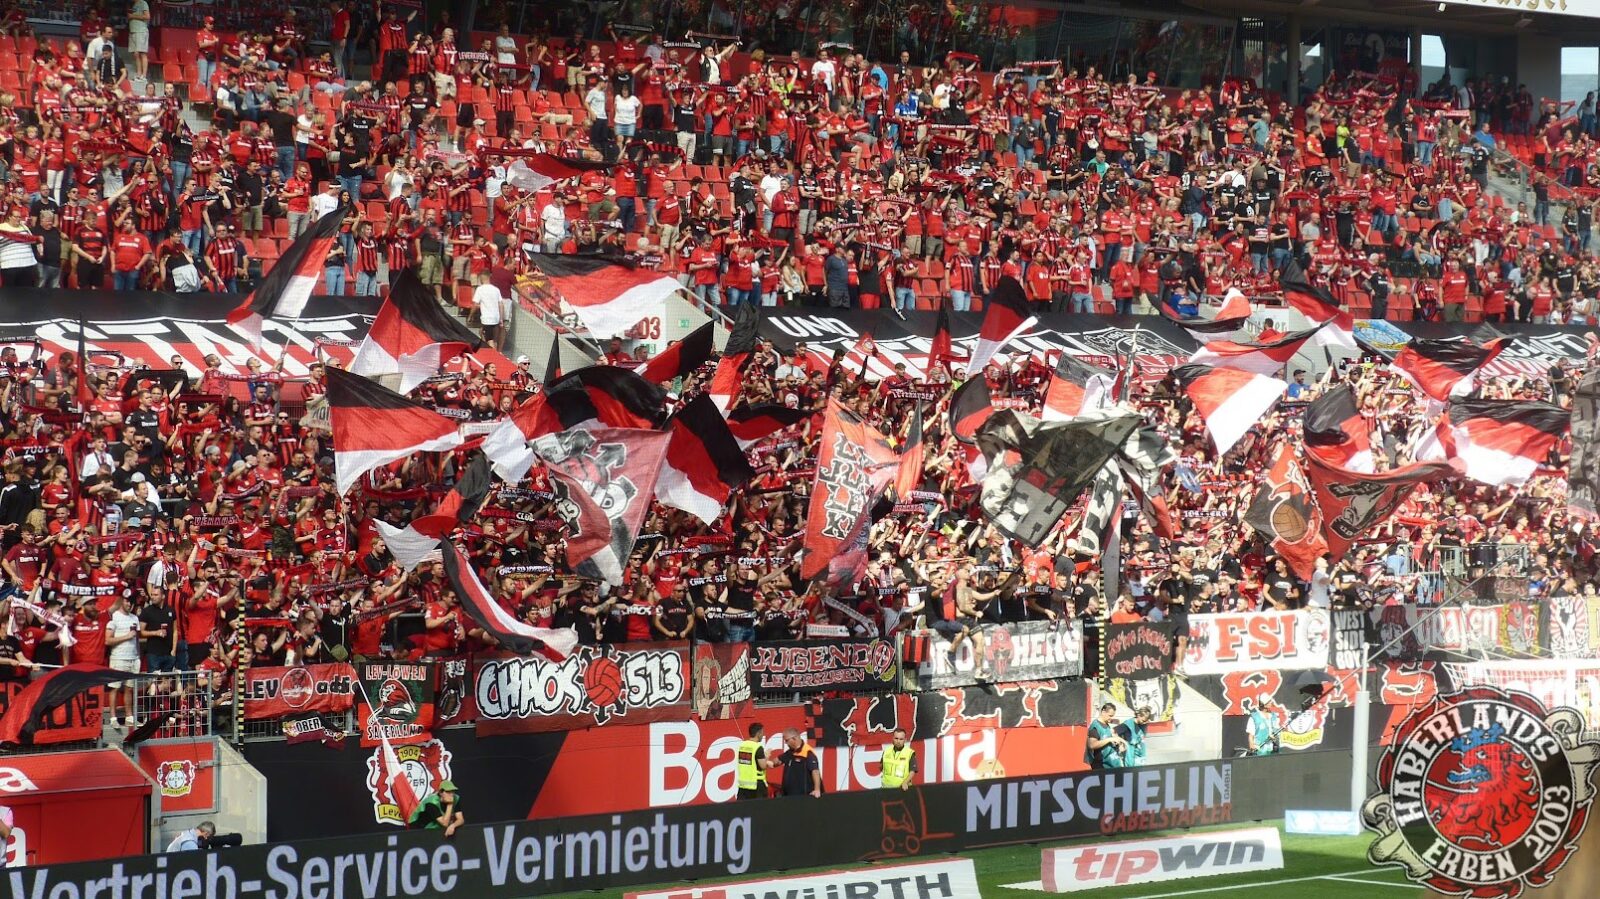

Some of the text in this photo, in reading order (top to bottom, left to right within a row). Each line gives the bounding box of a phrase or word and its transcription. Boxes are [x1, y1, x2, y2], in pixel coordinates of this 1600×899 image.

[768, 315, 859, 338] UND
[1334, 612, 1365, 630] WEST
[1214, 614, 1298, 662] FSI
[365, 664, 427, 681] LEV-LÖWEN
[750, 643, 875, 673] JUGEND
[1335, 650, 1363, 669] BOY
[476, 650, 684, 721] CHAOS 513
[761, 667, 867, 688] LEVERKUSEN
[648, 721, 996, 808] Bareia
[966, 763, 1231, 832] MITSCHELIN
[1100, 802, 1233, 835] GABELSTAPLER
[1072, 838, 1266, 884] tipwin
